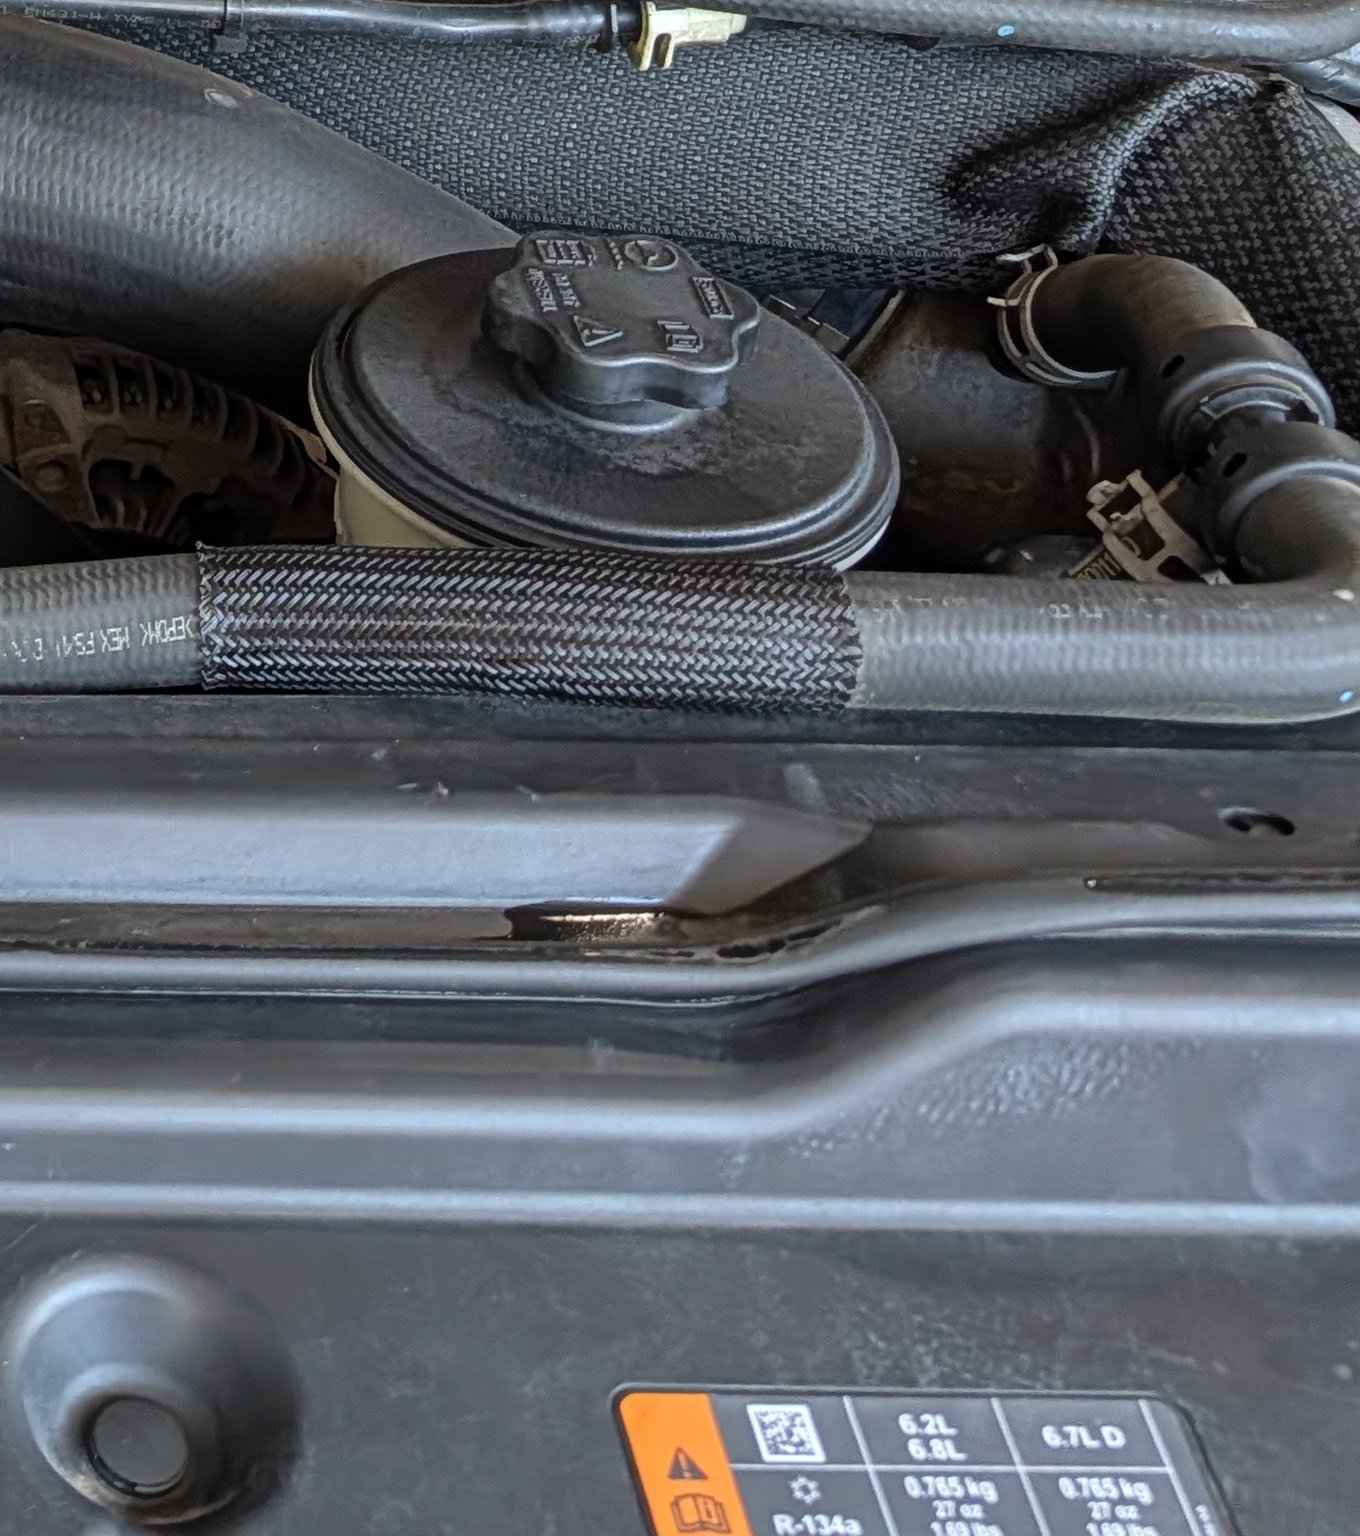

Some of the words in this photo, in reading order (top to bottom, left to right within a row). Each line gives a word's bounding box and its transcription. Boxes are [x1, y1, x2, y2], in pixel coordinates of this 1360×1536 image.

[898, 1413, 958, 1436] 6.2L
[1041, 1424, 1100, 1449] 6.7L
[1101, 1425, 1127, 1449] D
[907, 1438, 968, 1461] 6.8L
[904, 1475, 965, 1499] 0.765
[965, 1476, 999, 1504] kg
[1058, 1476, 1119, 1500] 0.765
[1121, 1477, 1154, 1506] kg
[932, 1500, 956, 1519] 27
[959, 1502, 985, 1519] oz
[1086, 1501, 1112, 1520] 27
[1114, 1505, 1141, 1520] oz
[771, 1514, 864, 1536] R-134a
